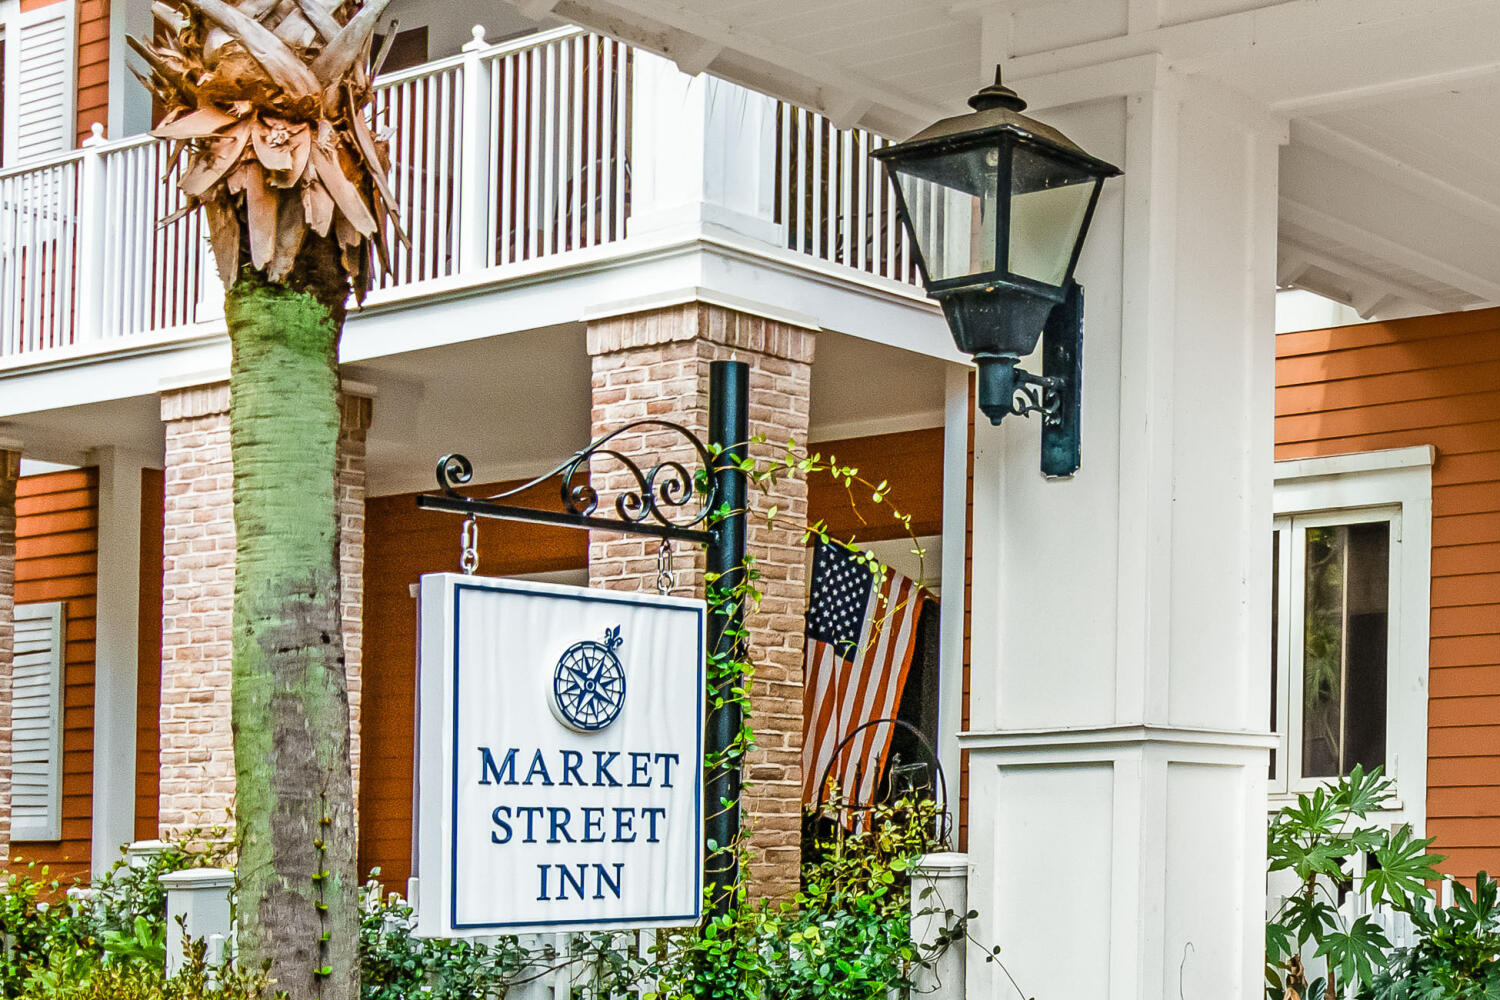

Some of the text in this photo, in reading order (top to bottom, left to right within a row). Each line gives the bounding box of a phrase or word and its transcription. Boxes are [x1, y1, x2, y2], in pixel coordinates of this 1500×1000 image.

[477, 746, 679, 788] MARKET
[491, 805, 666, 844] STREET
[536, 863, 625, 901] INN
